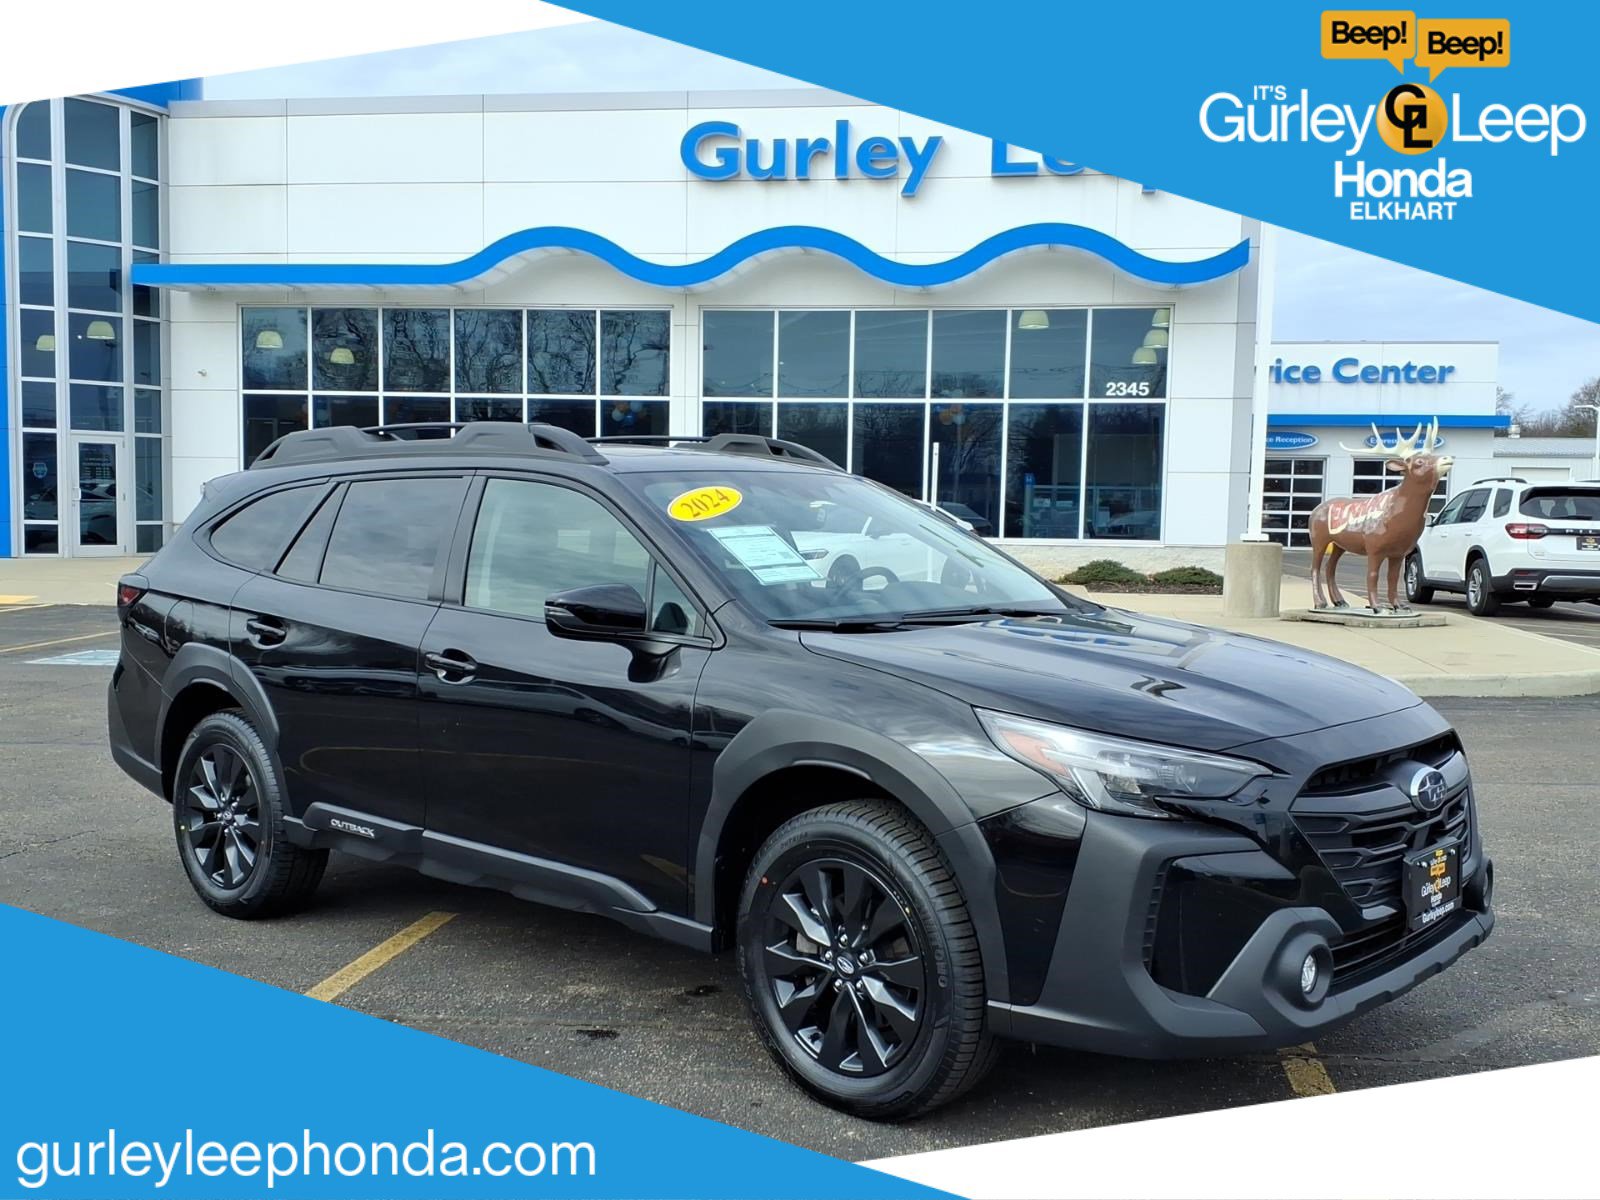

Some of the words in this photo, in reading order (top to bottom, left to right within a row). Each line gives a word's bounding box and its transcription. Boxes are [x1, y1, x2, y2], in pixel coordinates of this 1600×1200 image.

[680, 119, 943, 198] Gurley
[1332, 357, 1455, 384] Center
[1105, 381, 1150, 397] 2345
[1275, 436, 1314, 445] Reception
[680, 487, 731, 518] 2024
[330, 818, 375, 838] OUTBACK
